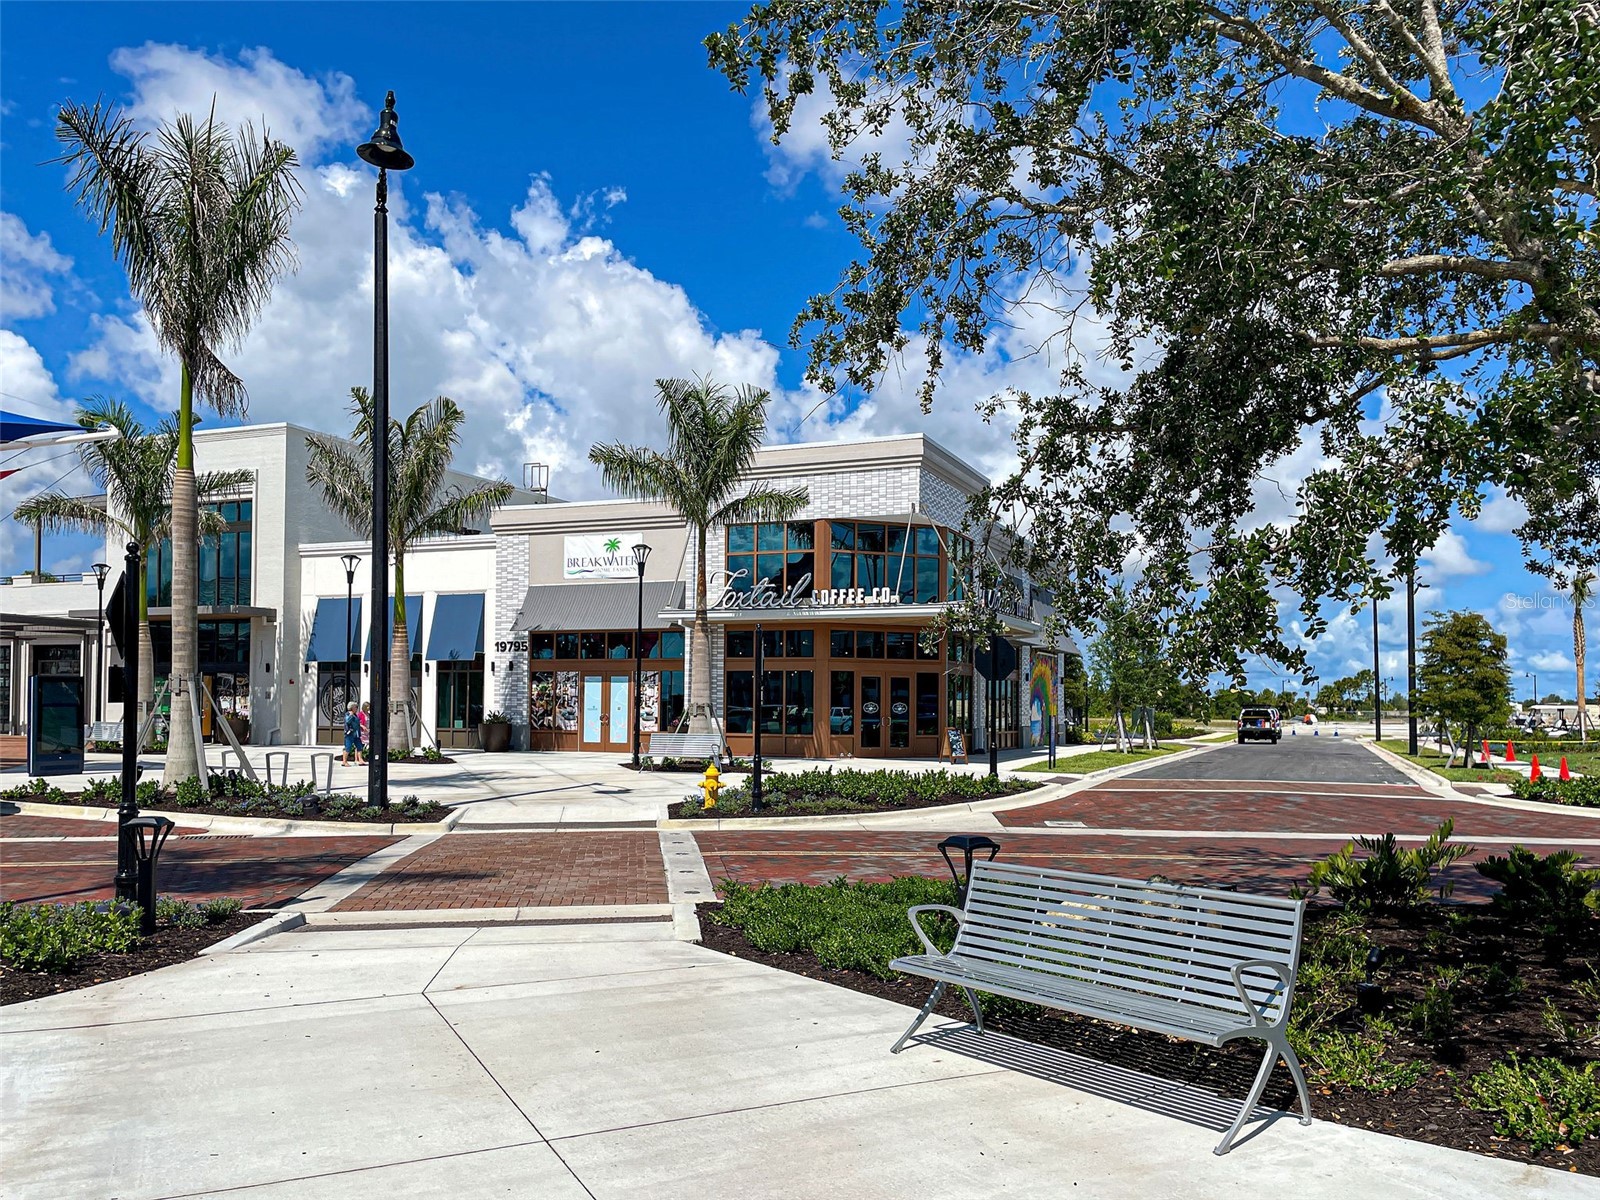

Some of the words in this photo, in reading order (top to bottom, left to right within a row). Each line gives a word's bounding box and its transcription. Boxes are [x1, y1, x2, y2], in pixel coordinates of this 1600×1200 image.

[567, 555, 639, 568] BREAKWATER
[707, 568, 812, 609] Foxtail
[811, 587, 865, 605] COFFEE
[494, 640, 528, 652] 19795
